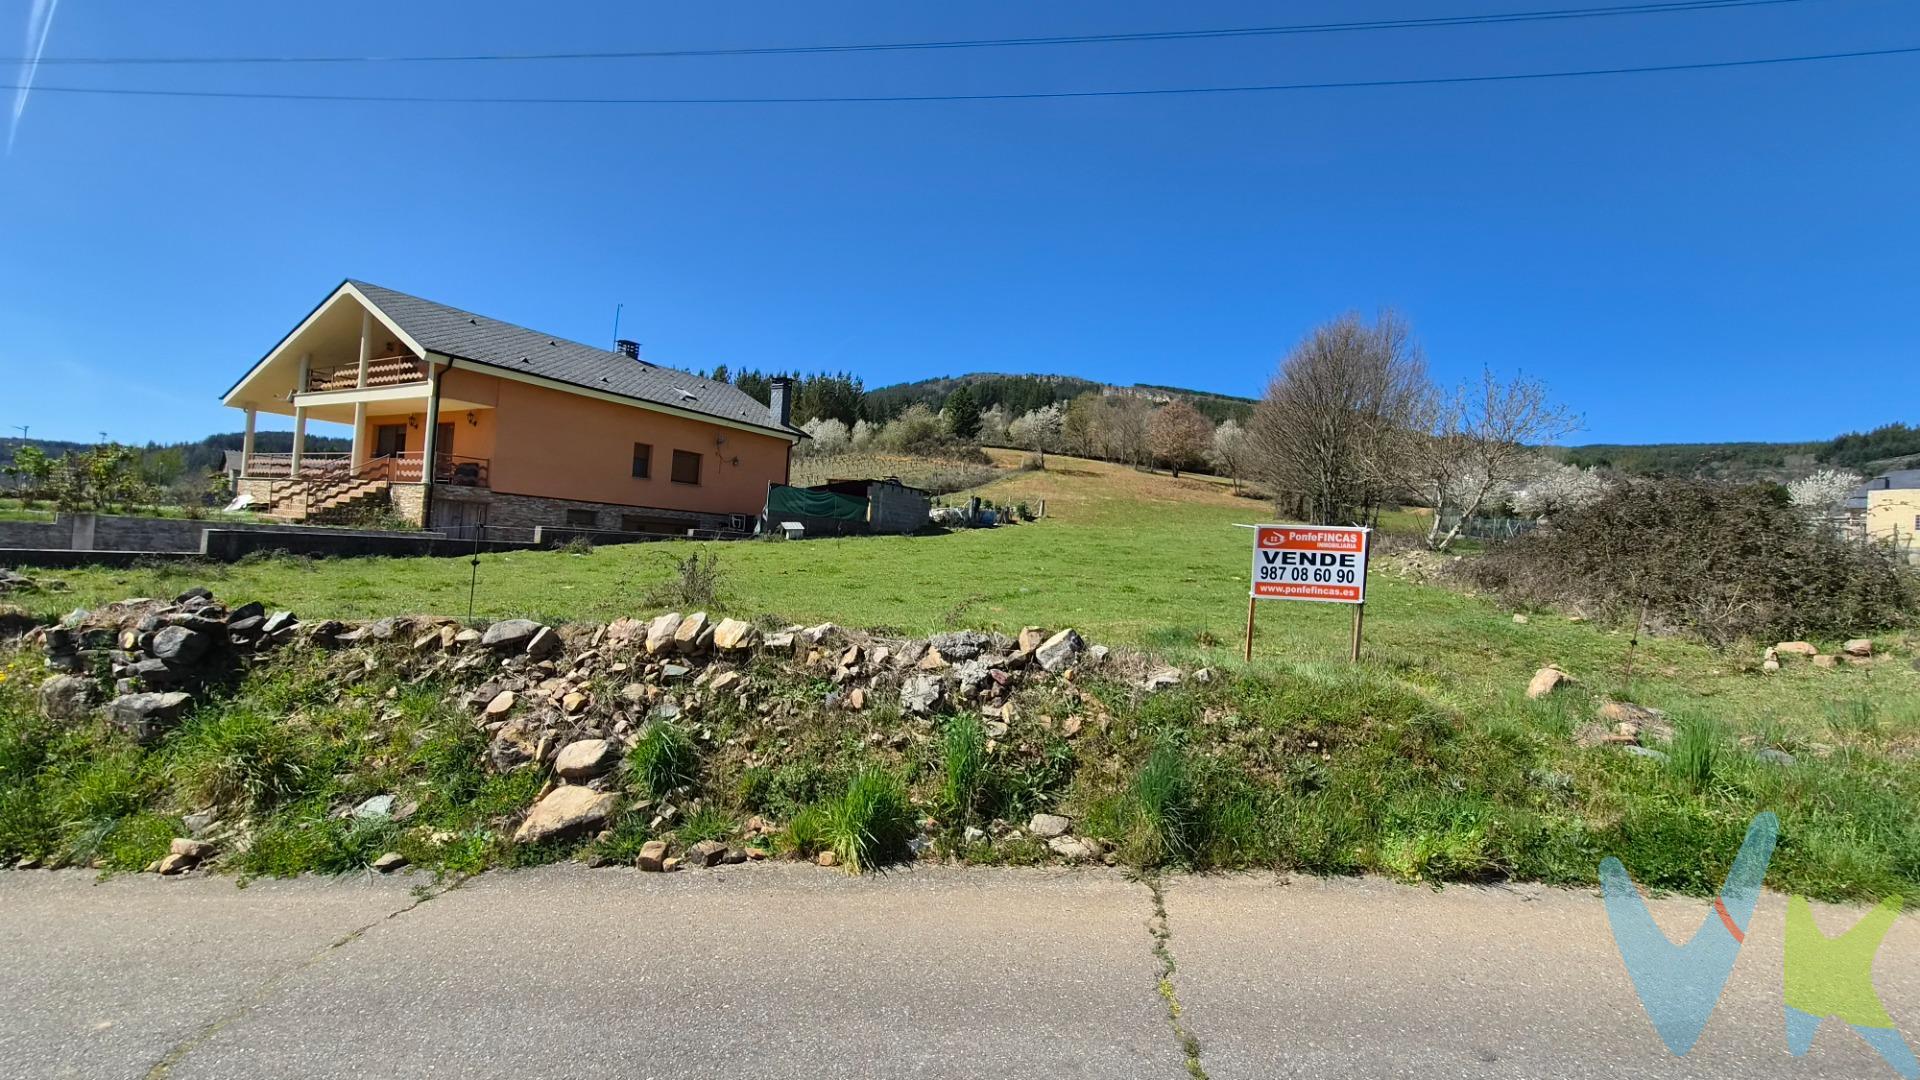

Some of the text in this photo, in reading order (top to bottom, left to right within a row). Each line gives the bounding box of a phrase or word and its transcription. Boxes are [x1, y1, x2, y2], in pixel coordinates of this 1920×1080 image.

[1262, 551, 1356, 567] VENDE
[1260, 566, 1355, 584] 987 08 60 90
[1260, 585, 1355, 597] www.ponfefincas.es
